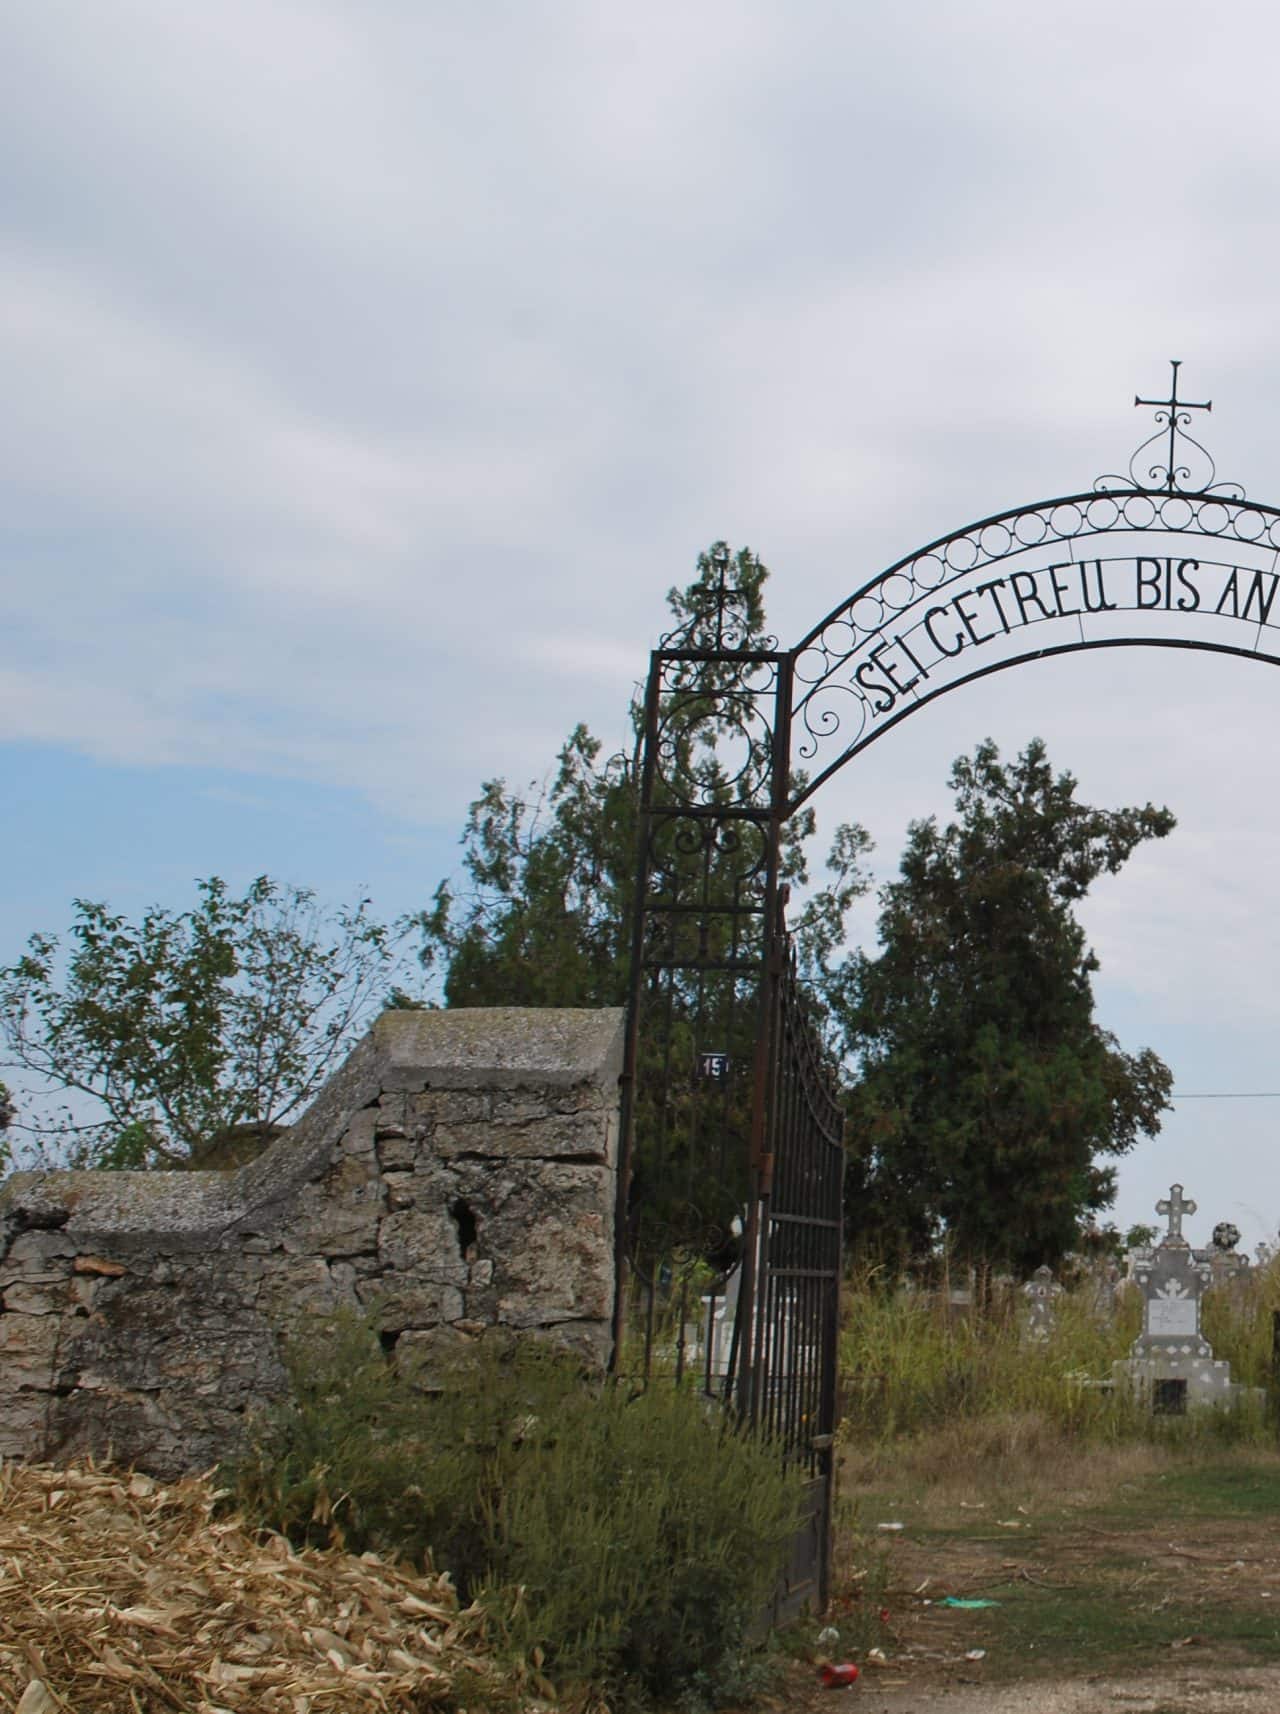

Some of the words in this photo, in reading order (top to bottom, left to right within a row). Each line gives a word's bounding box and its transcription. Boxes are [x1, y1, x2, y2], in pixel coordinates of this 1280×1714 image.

[855, 634, 930, 713] SEI
[1136, 556, 1201, 612] BIS
[1215, 566, 1280, 625] AN
